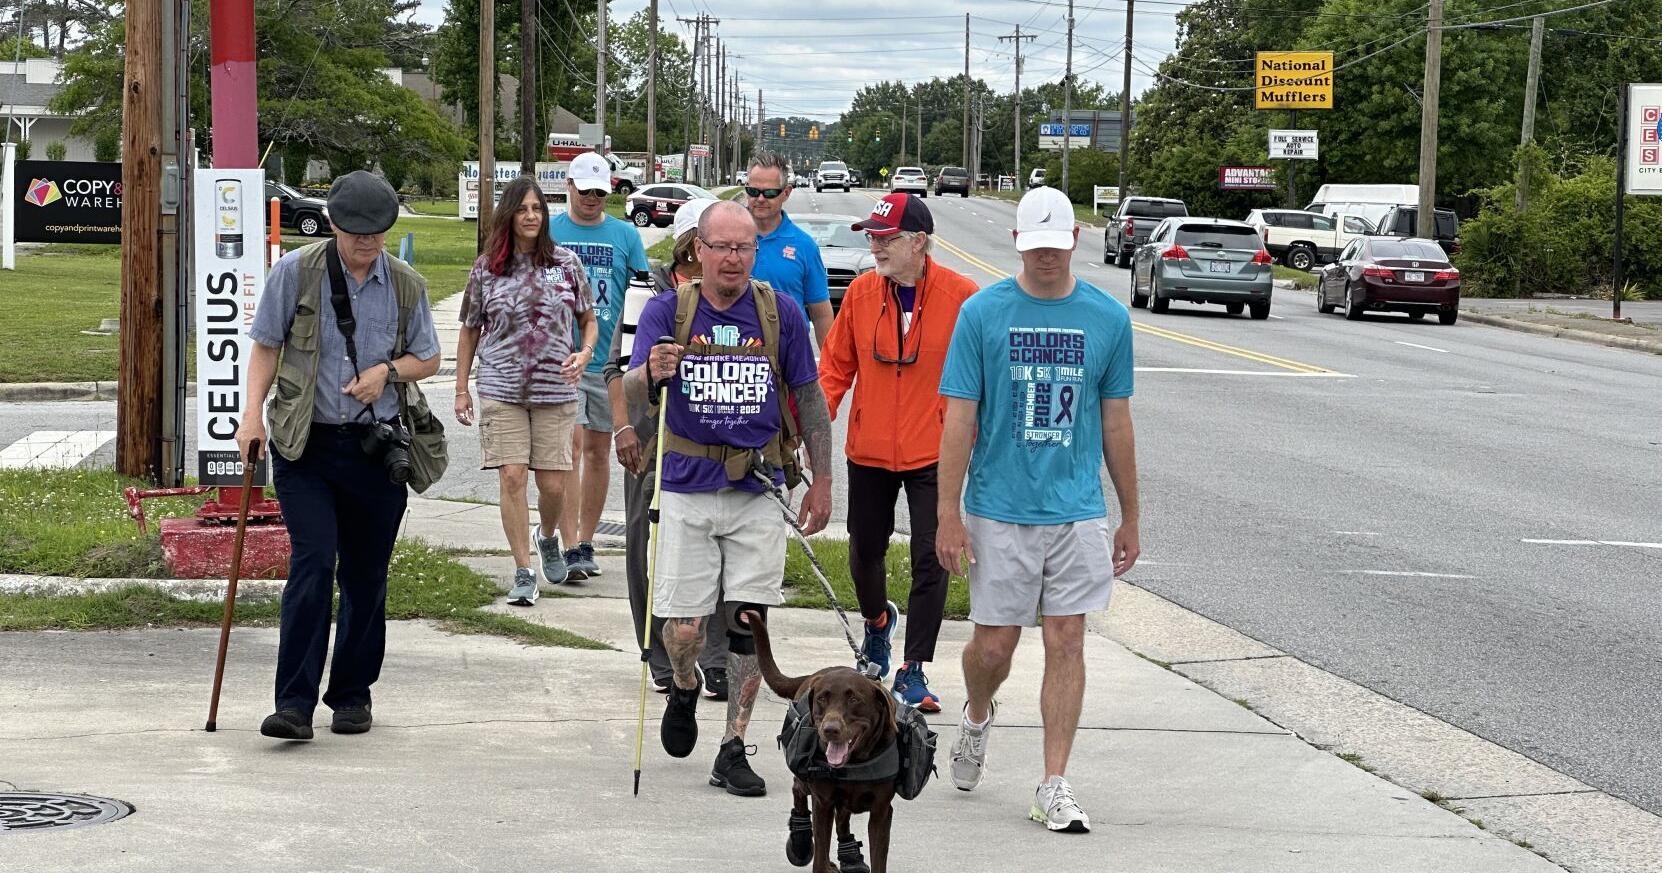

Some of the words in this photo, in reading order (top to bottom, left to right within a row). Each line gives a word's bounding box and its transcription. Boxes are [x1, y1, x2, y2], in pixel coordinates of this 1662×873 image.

[1261, 60, 1326, 71] National
[1261, 75, 1331, 87] Discount
[1261, 91, 1327, 102] Mufflers
[1645, 109, 1657, 120] C
[1273, 135, 1287, 143] FULL
[1291, 135, 1314, 143] SERVICE
[1645, 130, 1655, 141] E
[1644, 150, 1655, 162] S
[537, 168, 567, 180] uare
[1225, 168, 1276, 177] ADVANTA
[872, 199, 894, 218] SA
[243, 273, 256, 297] FIT
[1009, 332, 1085, 350] COLORS
[206, 271, 240, 441] CELSIUS
[1021, 348, 1085, 366] CANCER
[680, 360, 770, 384] COLORS
[1009, 365, 1033, 381] 10K
[1036, 366, 1052, 379] 5K
[1061, 367, 1084, 377] MILE
[689, 381, 769, 404] CANCER
[740, 405, 761, 415] 2023
[1025, 382, 1036, 428] NOVEMBER
[1034, 382, 1052, 428] 2022
[699, 415, 724, 430] stronger
[724, 415, 750, 431] together
[1025, 431, 1061, 440] STRONGER
